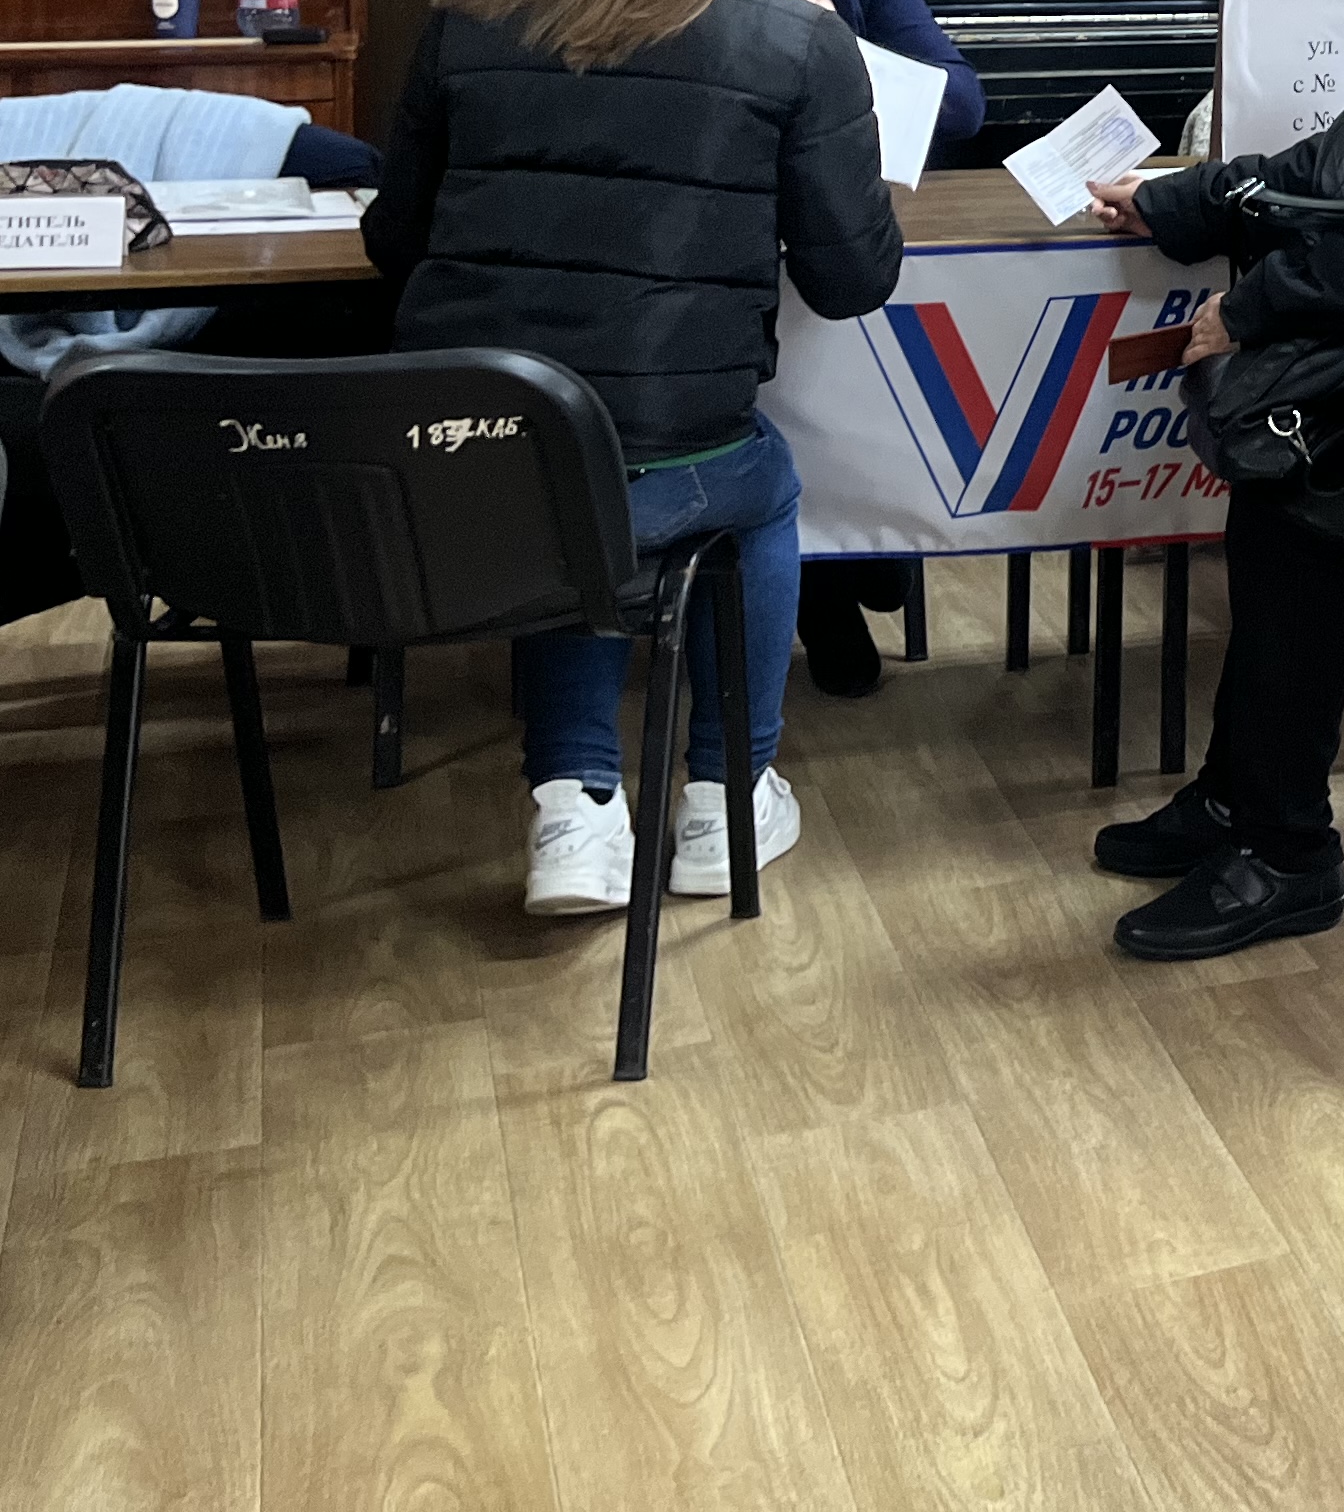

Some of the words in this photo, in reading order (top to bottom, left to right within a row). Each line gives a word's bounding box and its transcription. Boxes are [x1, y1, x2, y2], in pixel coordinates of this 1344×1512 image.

[1308, 40, 1339, 61] ул.
[1293, 81, 1304, 94] с
[1311, 74, 1336, 93] №
[1293, 118, 1304, 132] с
